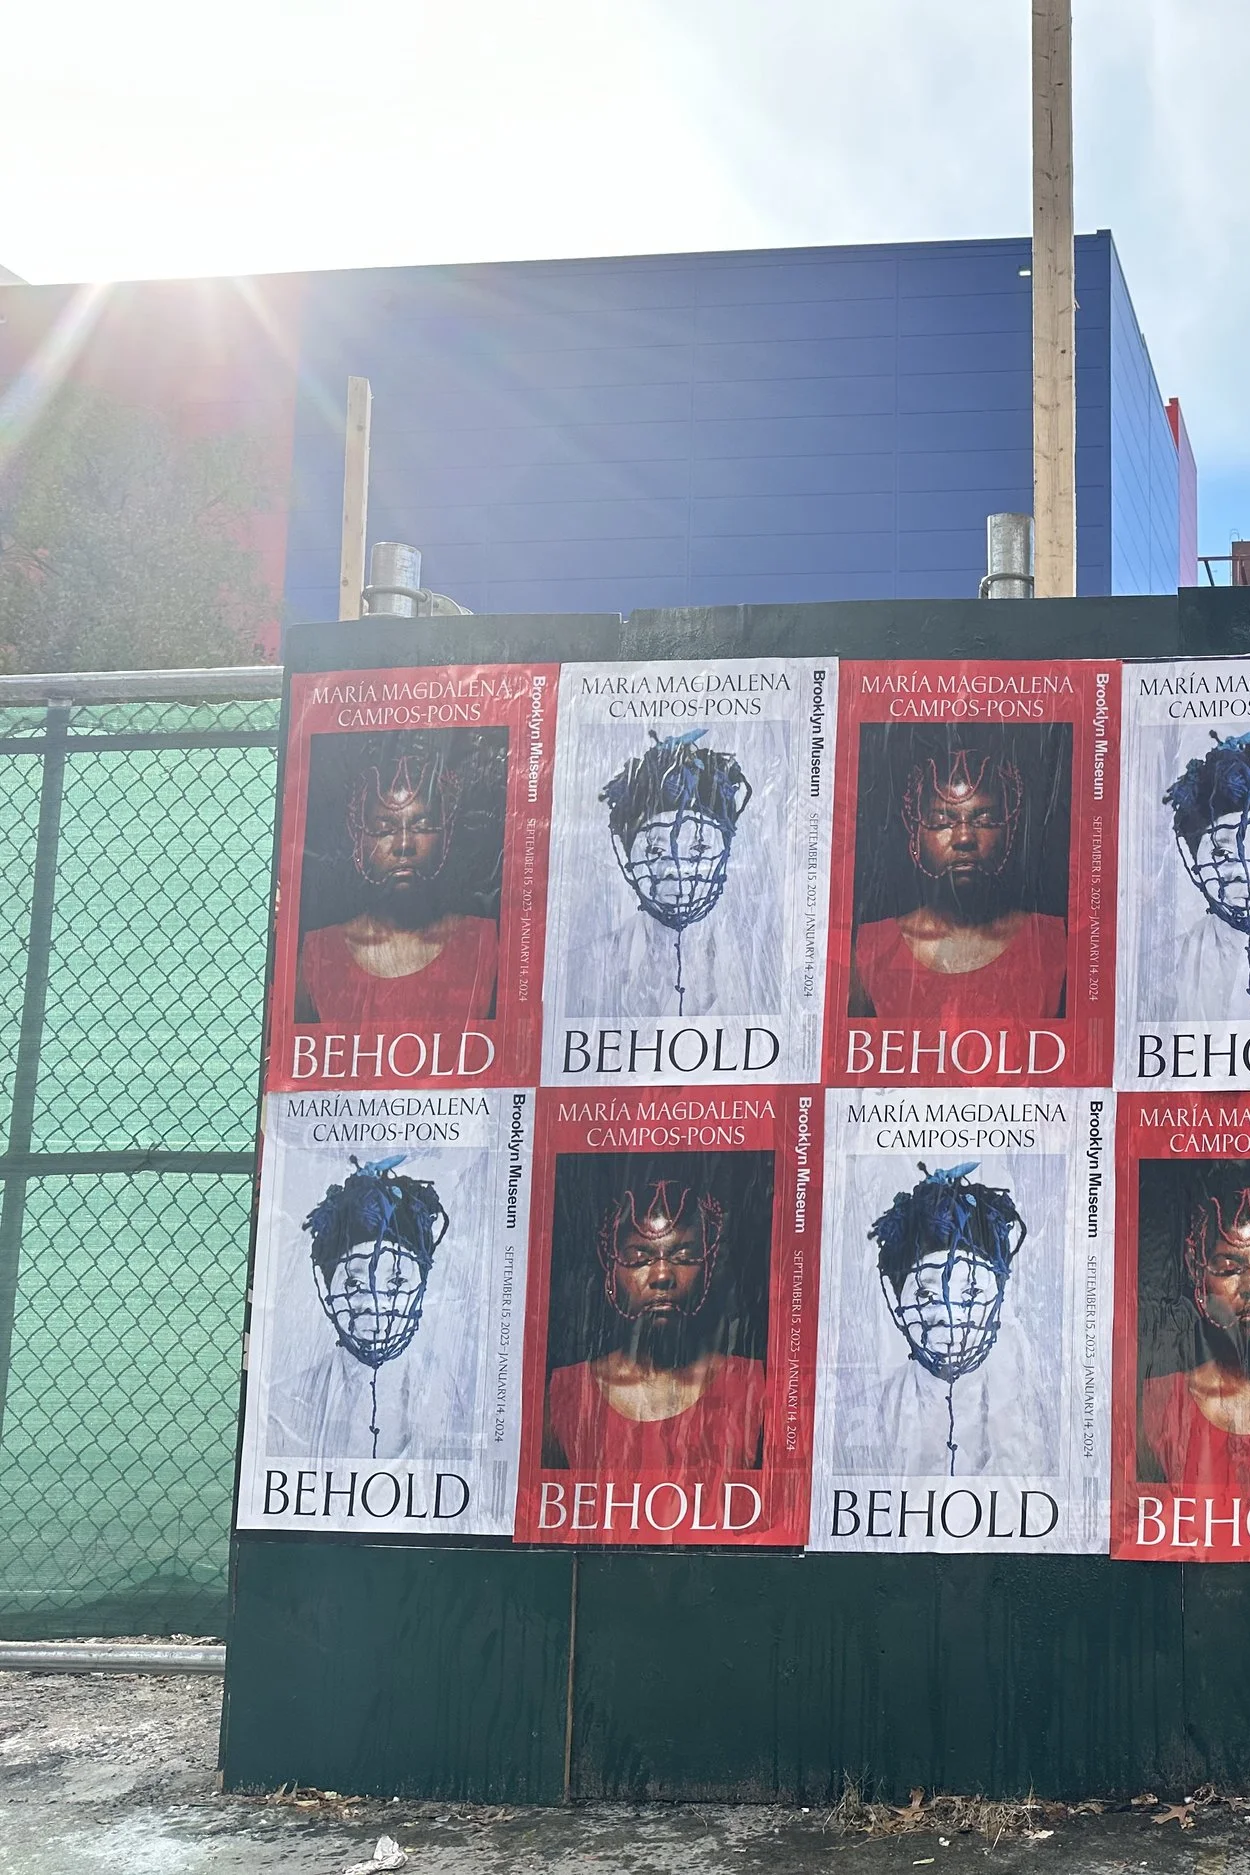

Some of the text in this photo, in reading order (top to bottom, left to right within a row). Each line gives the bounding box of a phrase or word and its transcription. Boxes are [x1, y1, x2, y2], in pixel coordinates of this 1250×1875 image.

[312, 679, 509, 703] MARÍA MAGDALENA
[655, 673, 790, 693] MAGDALENA
[861, 671, 1074, 694] MARÍA MAGDALENA
[1139, 672, 1210, 695] MARÍA
[336, 703, 481, 726] CAMPOS-PONS
[609, 696, 761, 718] CAMPOS-PONS
[889, 698, 1043, 717] CAMPOS-PONS
[527, 675, 546, 802] Brooklyn Museum
[809, 671, 826, 796] Brooklyn Museum
[1092, 673, 1109, 800] Brooklyn Museum
[1091, 816, 1102, 873] SEPTEMBER
[1088, 977, 1099, 1001] 2024
[290, 1033, 496, 1077] BEHOLD
[563, 1027, 780, 1073] BEHOLD
[845, 1029, 1065, 1074] BEHOLD
[286, 1093, 489, 1118] MARÍA MAGDALENA
[559, 1097, 776, 1121] MARÍA MAGDALENA
[847, 1098, 1066, 1123] MARÍA MAGDALENA
[1140, 1103, 1213, 1127] MARÍA
[311, 1121, 459, 1142] CAMPOS-PONS
[588, 1125, 745, 1147] CAMPOS-PONS
[876, 1127, 1034, 1148] CAMPOS-PONS
[506, 1094, 525, 1228] Brooklyn Museum
[794, 1097, 813, 1233] Brooklyn Museum
[1086, 1101, 1103, 1238] Brooklyn Museum
[502, 1245, 514, 1306] SEPTEMBER
[791, 1250, 804, 1312] SEPTEMBER
[1086, 1255, 1098, 1317] SEPTEMBER
[494, 1417, 505, 1442] 2024
[786, 1425, 796, 1451] 2024
[1083, 1432, 1094, 1458] 2024
[261, 1470, 471, 1519] BEHOLD
[537, 1481, 762, 1530] BEHOLD
[831, 1489, 1059, 1539] BEHOLD
